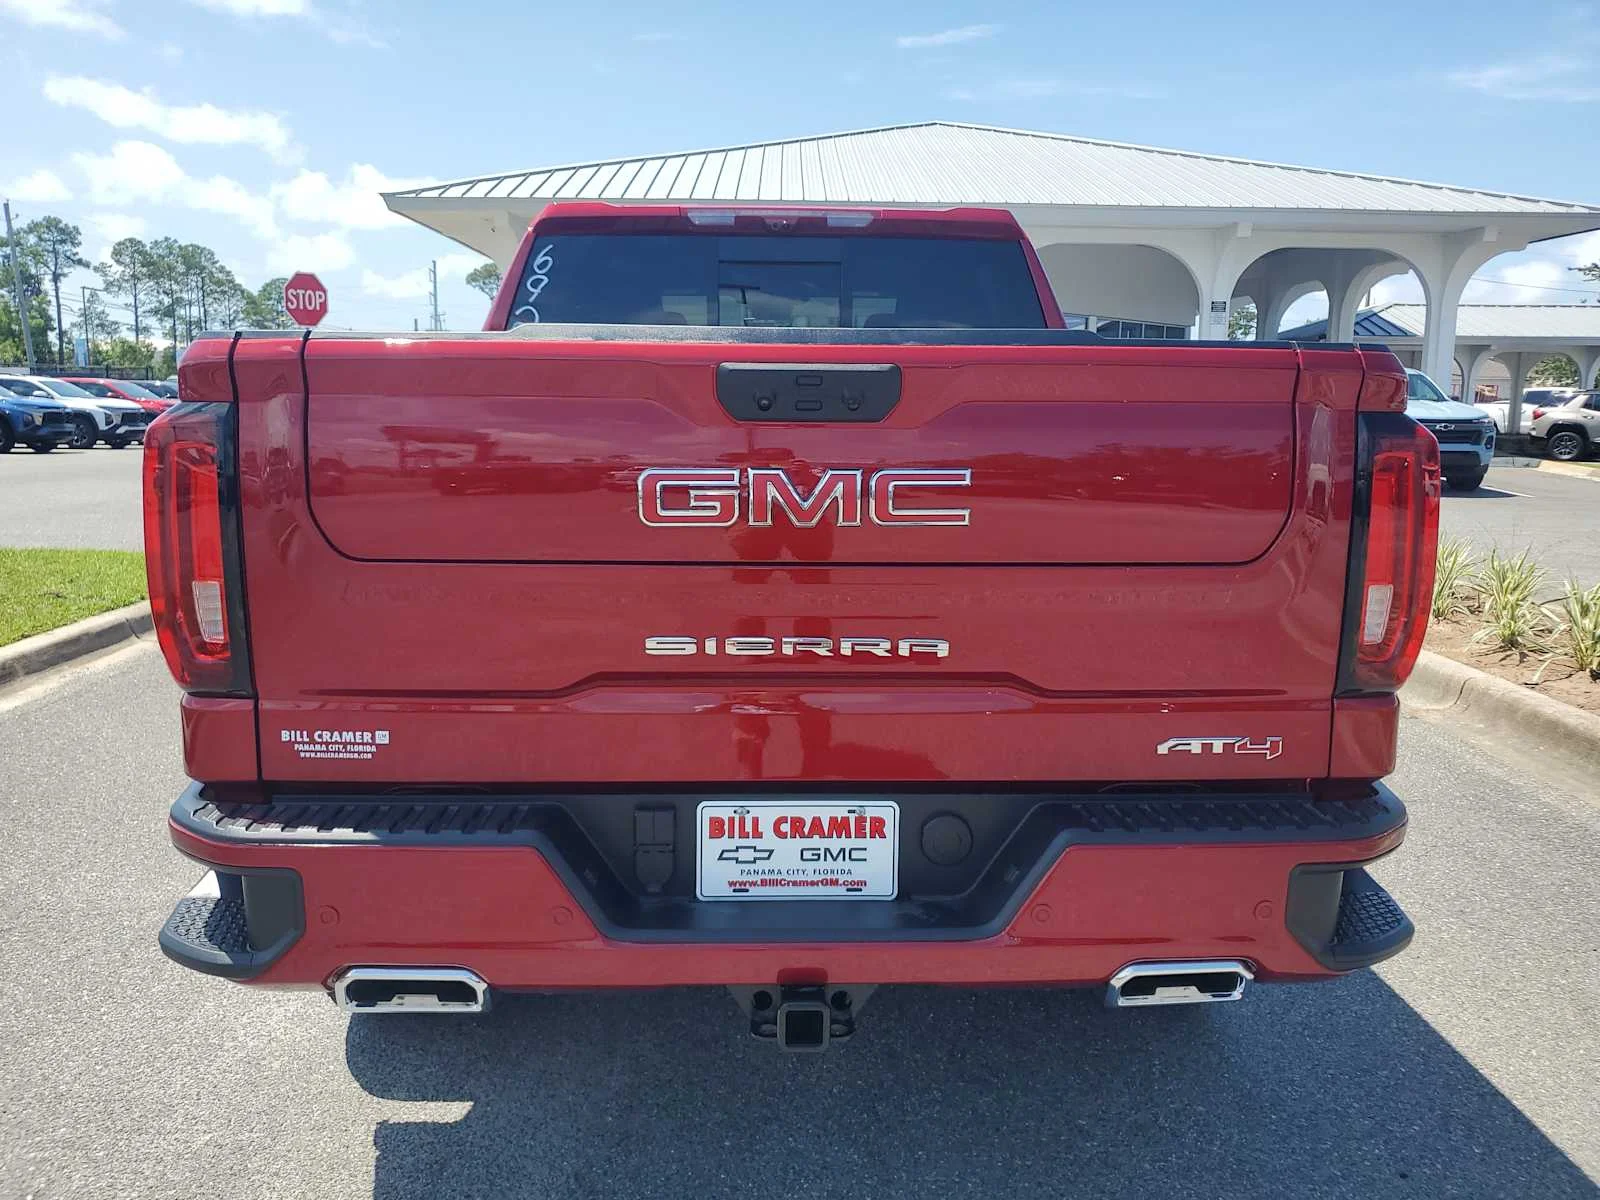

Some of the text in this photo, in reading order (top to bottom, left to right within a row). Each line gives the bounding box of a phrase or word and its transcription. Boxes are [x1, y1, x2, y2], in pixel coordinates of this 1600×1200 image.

[287, 288, 325, 310] STOP
[637, 467, 972, 527] GMC
[644, 636, 950, 657] SIERRA
[281, 730, 373, 743] BILL CRAMER
[328, 744, 345, 752] CITY,
[346, 744, 377, 752] FLORIDA
[1157, 736, 1282, 760] AT4
[708, 816, 887, 840] BILL CRAMER
[800, 847, 867, 862] GMC
[786, 869, 809, 877] CITY,
[727, 878, 867, 888] www.BillCramerGM.com
